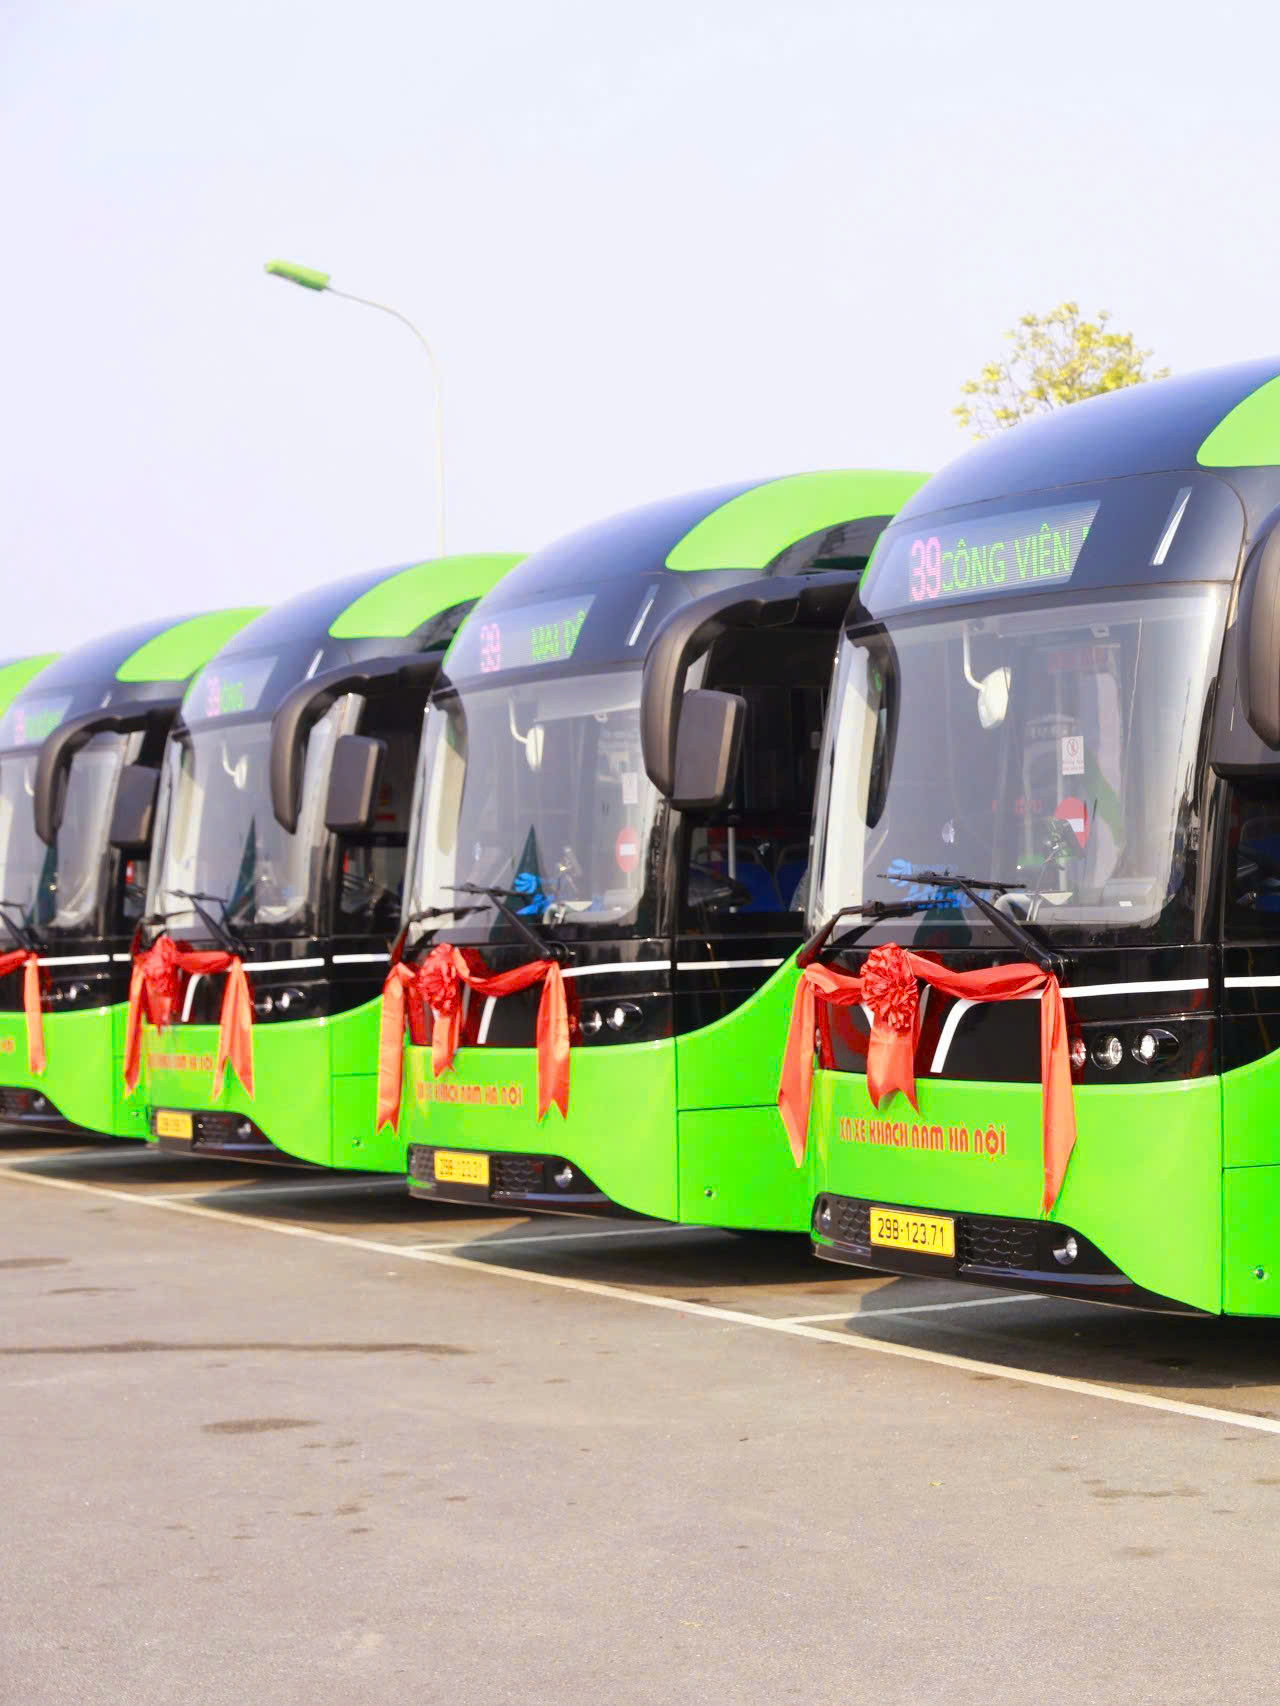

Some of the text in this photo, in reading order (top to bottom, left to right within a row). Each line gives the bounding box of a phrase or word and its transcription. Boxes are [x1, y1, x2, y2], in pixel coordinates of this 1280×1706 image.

[911, 523, 1072, 600] 39 CÔNG VIÊN
[854, 1119, 866, 1142] XE
[912, 1123, 944, 1150] NAM
[949, 1121, 969, 1152] HÀ
